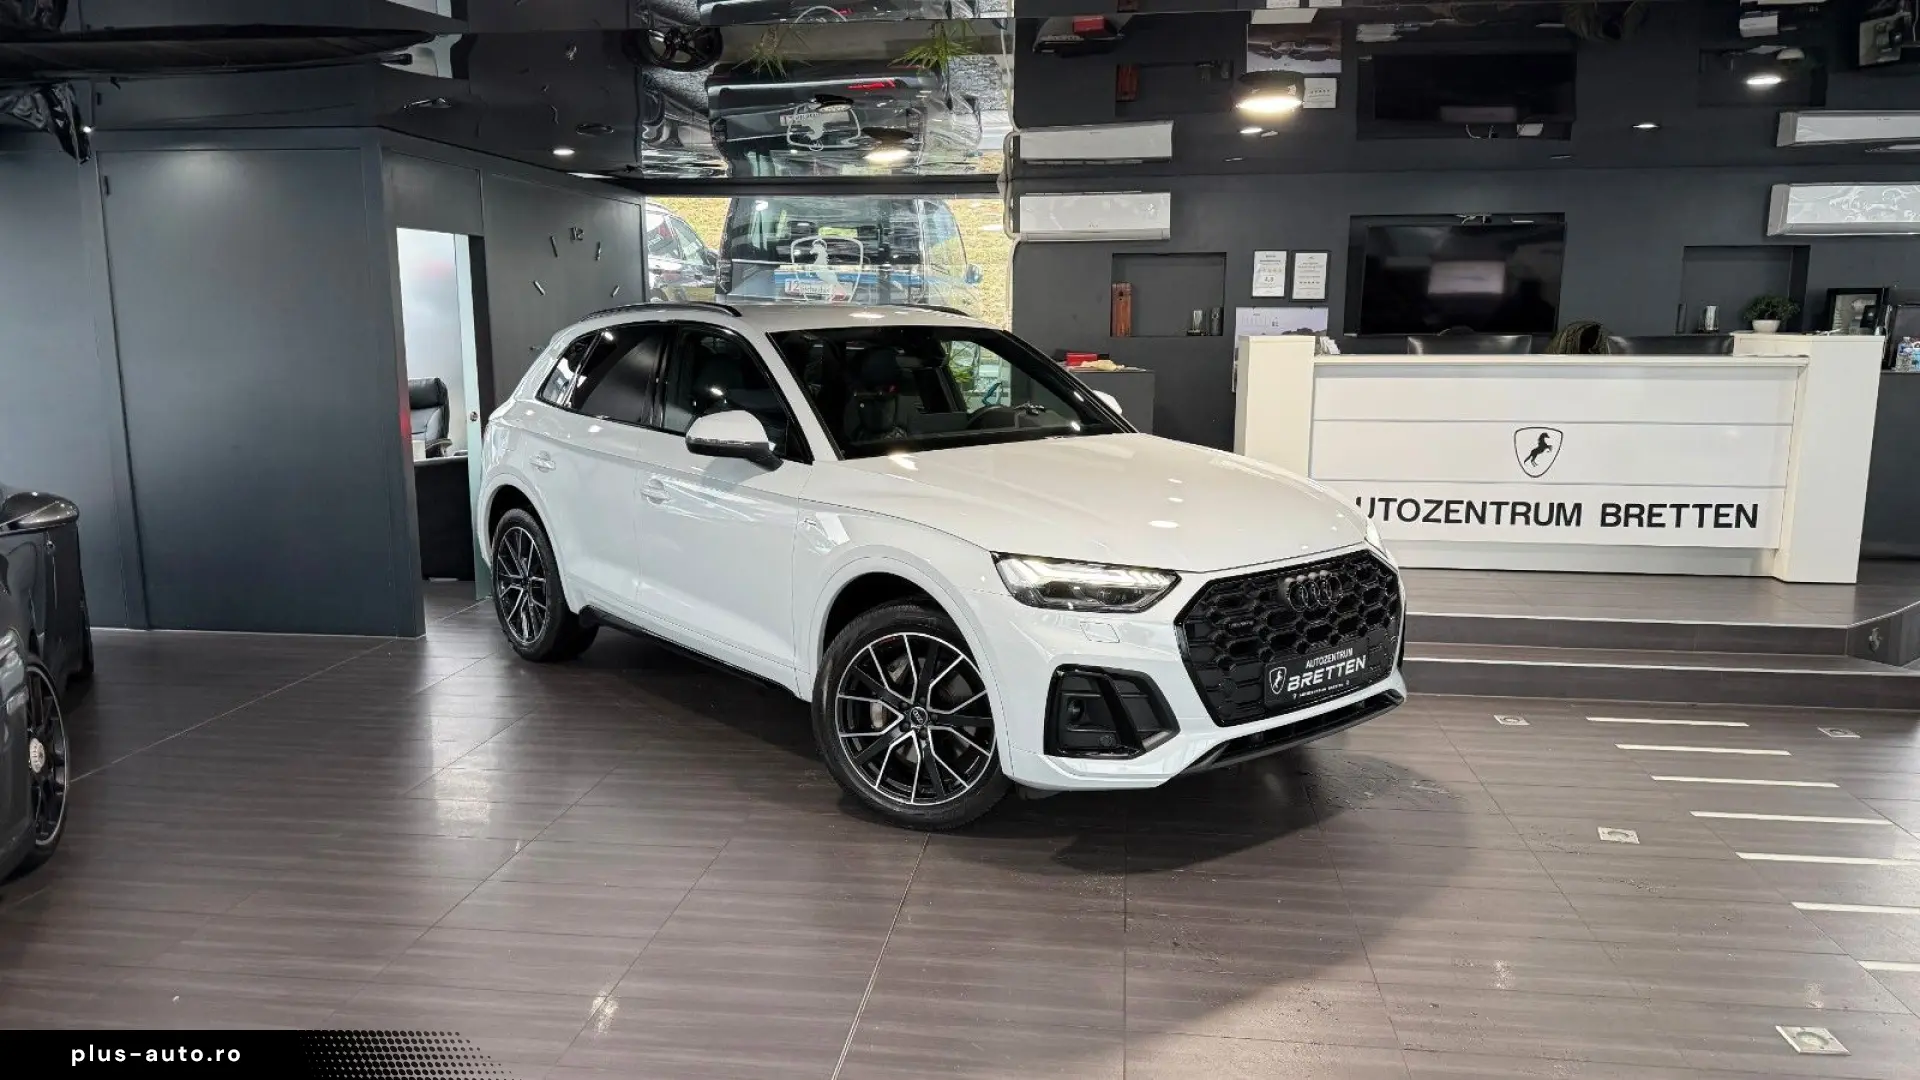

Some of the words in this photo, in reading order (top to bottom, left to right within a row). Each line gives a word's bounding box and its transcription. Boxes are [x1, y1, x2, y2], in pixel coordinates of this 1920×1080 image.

[1355, 496, 1582, 527] UTOZENTRUM
[1600, 503, 1759, 529] BRETTEN
[1287, 655, 1366, 692] BRETTEN
[1305, 648, 1354, 669] AUTOZENTRUM
